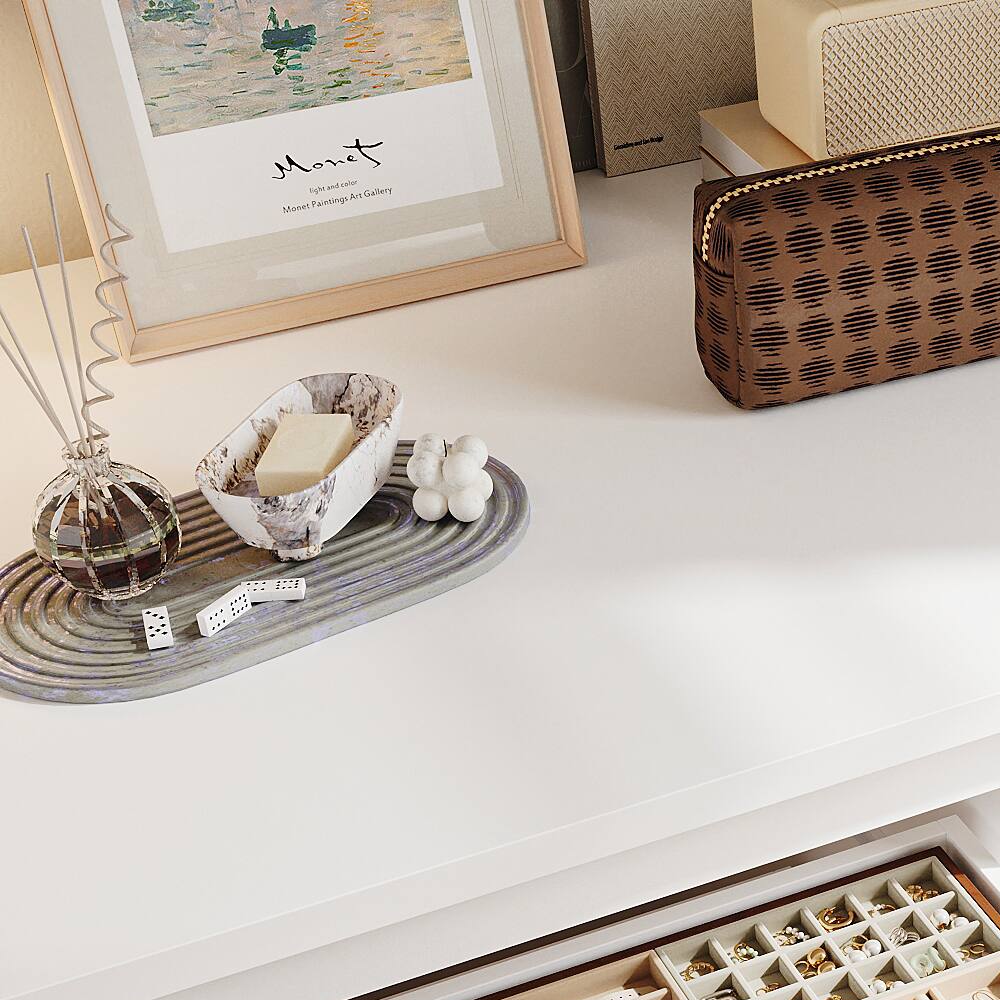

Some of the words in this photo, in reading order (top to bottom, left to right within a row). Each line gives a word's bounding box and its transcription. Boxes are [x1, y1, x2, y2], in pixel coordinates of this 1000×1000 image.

[272, 138, 383, 179] Monet
[282, 202, 310, 214] Monet
[311, 193, 349, 208] Paintings
[349, 192, 363, 201] Art
[363, 186, 393, 199] Gallery
[309, 186, 325, 195] light
[327, 182, 340, 191] and
[340, 179, 358, 188] color
